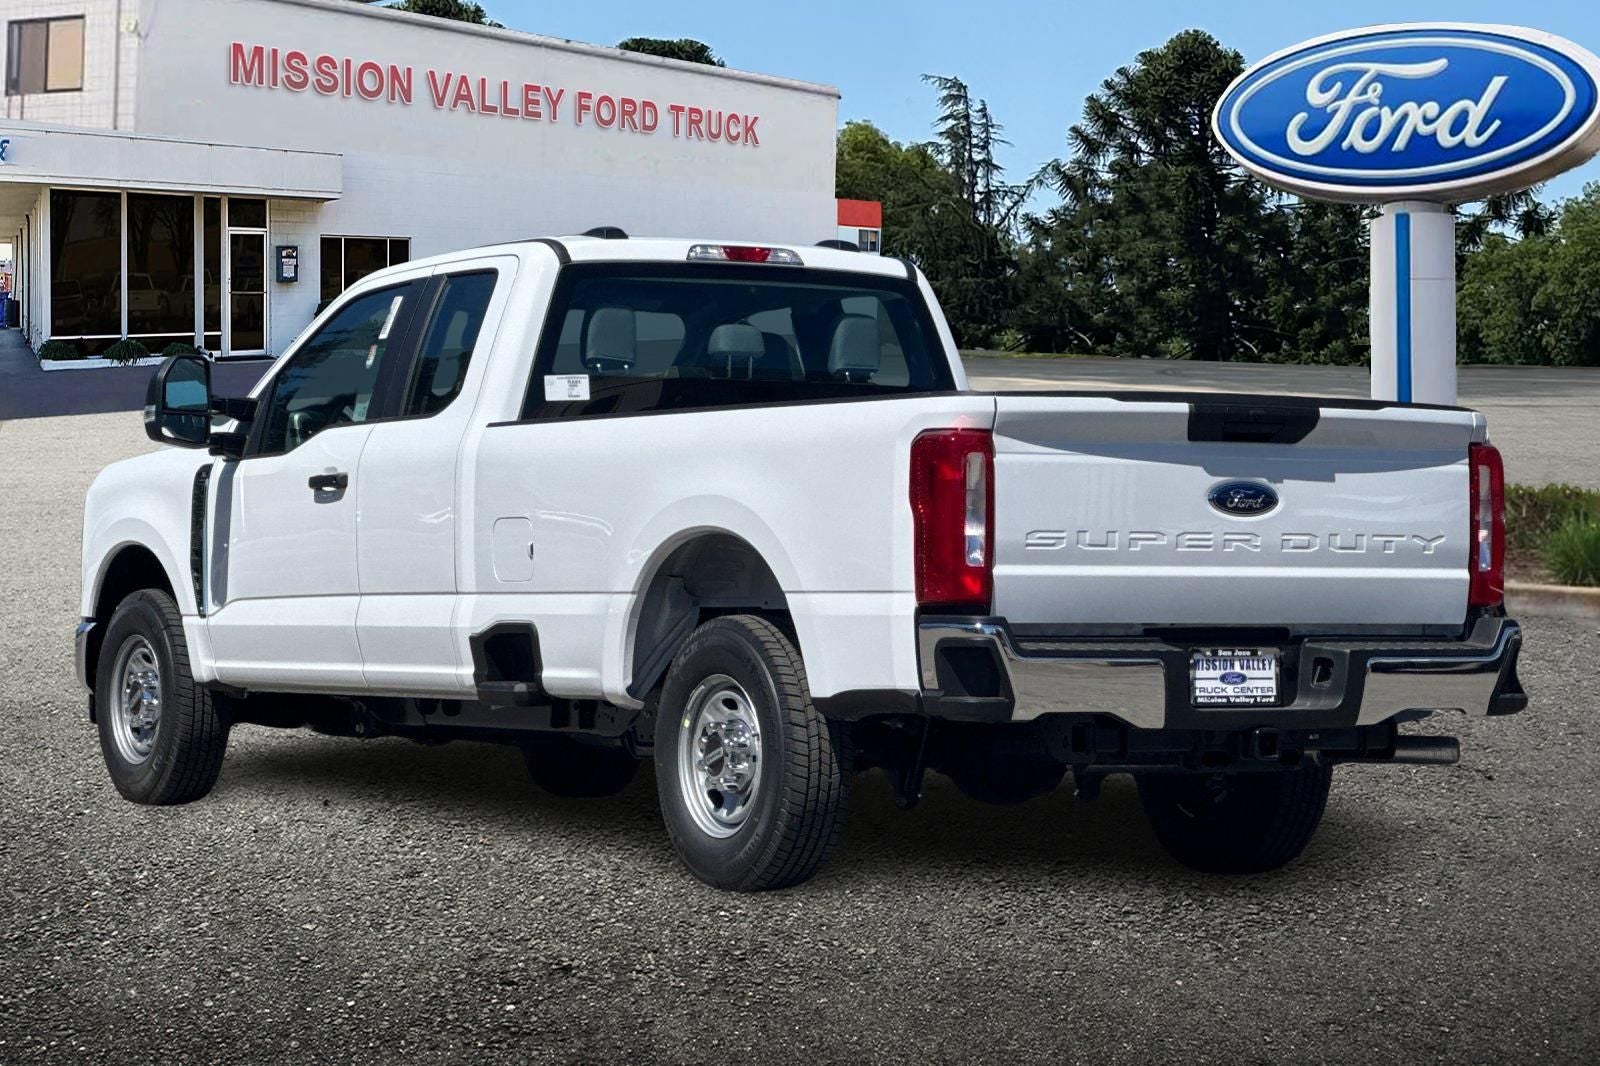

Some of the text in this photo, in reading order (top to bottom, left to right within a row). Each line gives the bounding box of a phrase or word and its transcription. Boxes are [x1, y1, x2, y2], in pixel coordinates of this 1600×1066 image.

[229, 41, 761, 146] MISSION VALLEY FORD TRUCK
[1286, 58, 1509, 156] Ford
[1226, 488, 1266, 508] Ford
[1025, 530, 1448, 554] SUPER DUTY
[1217, 649, 1251, 657] San Jose
[1194, 658, 1273, 671] MISSION VALLEY
[1232, 686, 1274, 694] CENTER
[1229, 696, 1255, 704] Valley
